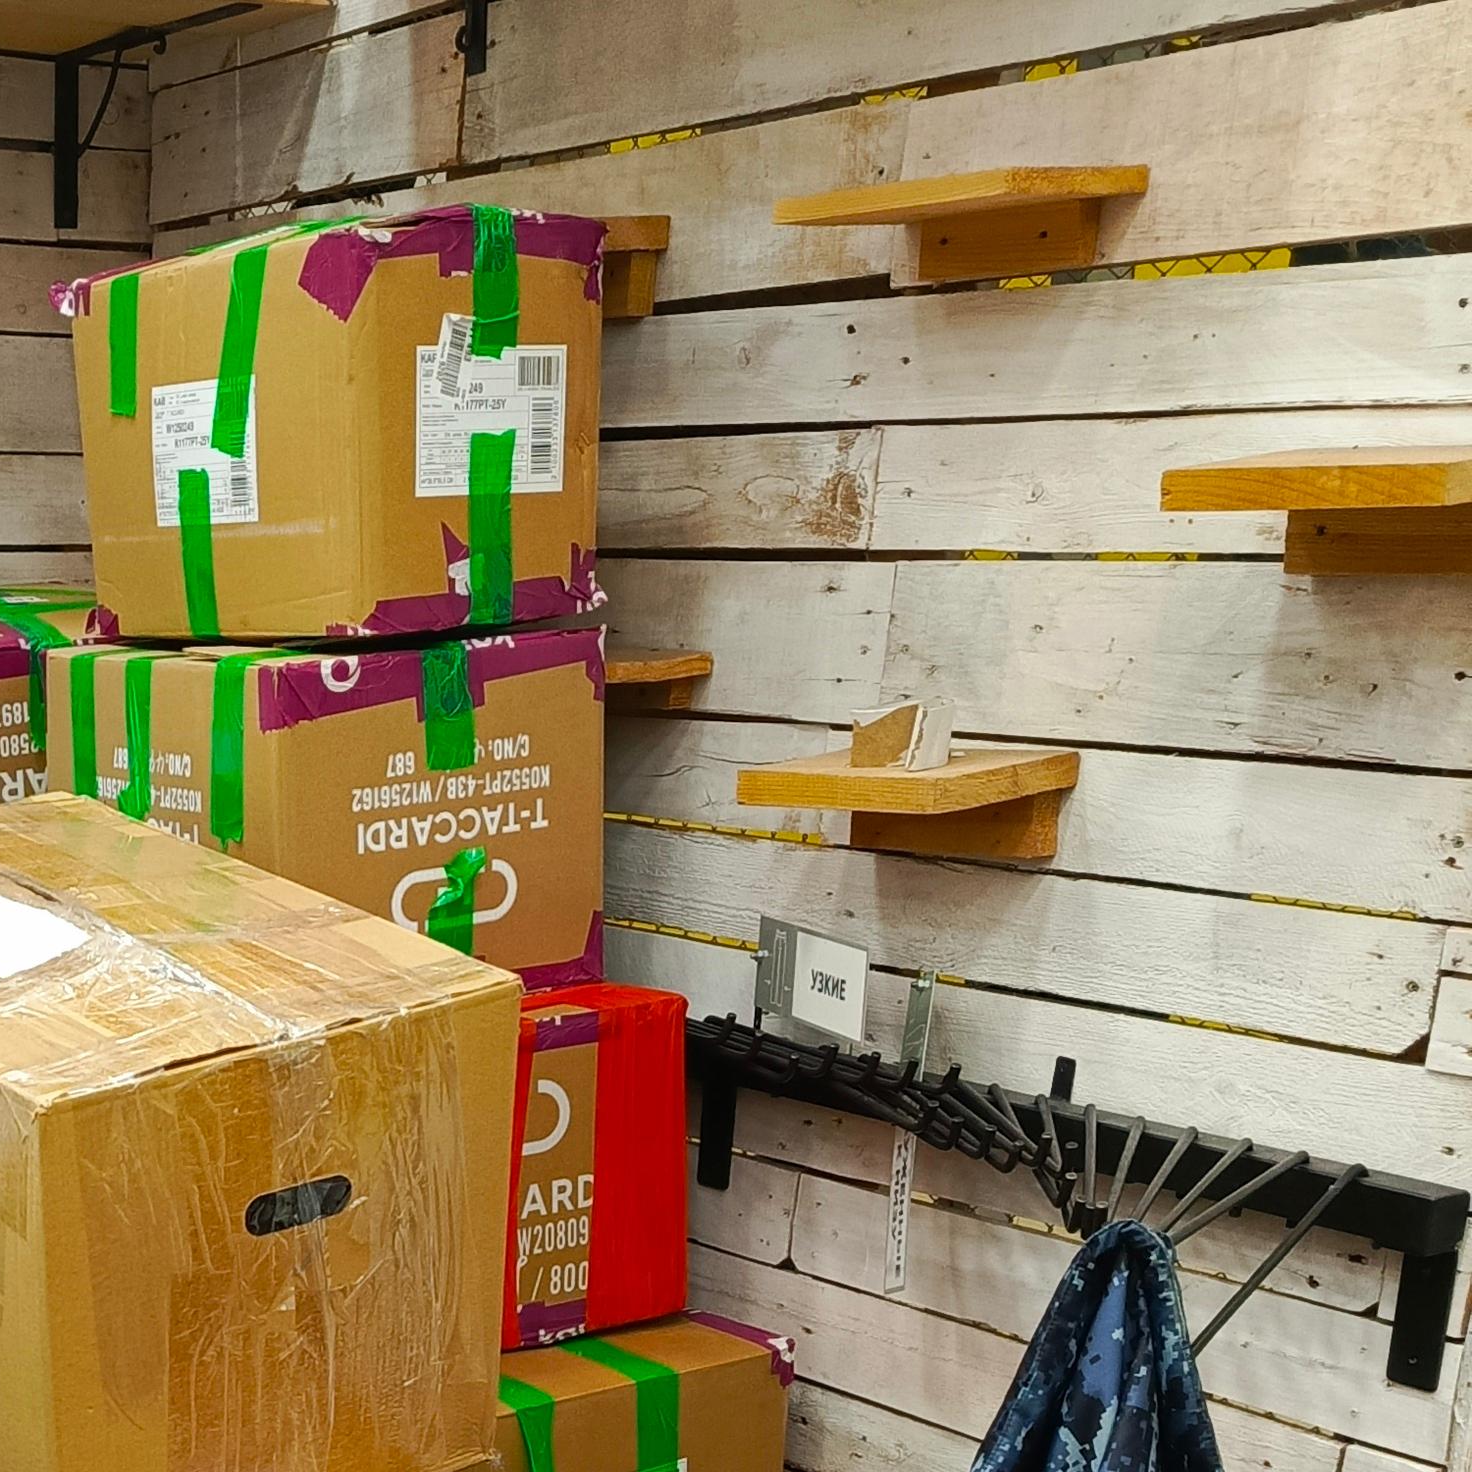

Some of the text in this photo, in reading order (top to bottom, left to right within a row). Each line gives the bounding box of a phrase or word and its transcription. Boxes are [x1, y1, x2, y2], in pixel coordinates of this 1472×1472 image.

[386, 751, 415, 777] 687
[357, 797, 549, 855] T-TACCARDI
[810, 968, 847, 1001] УЗКИЕ
